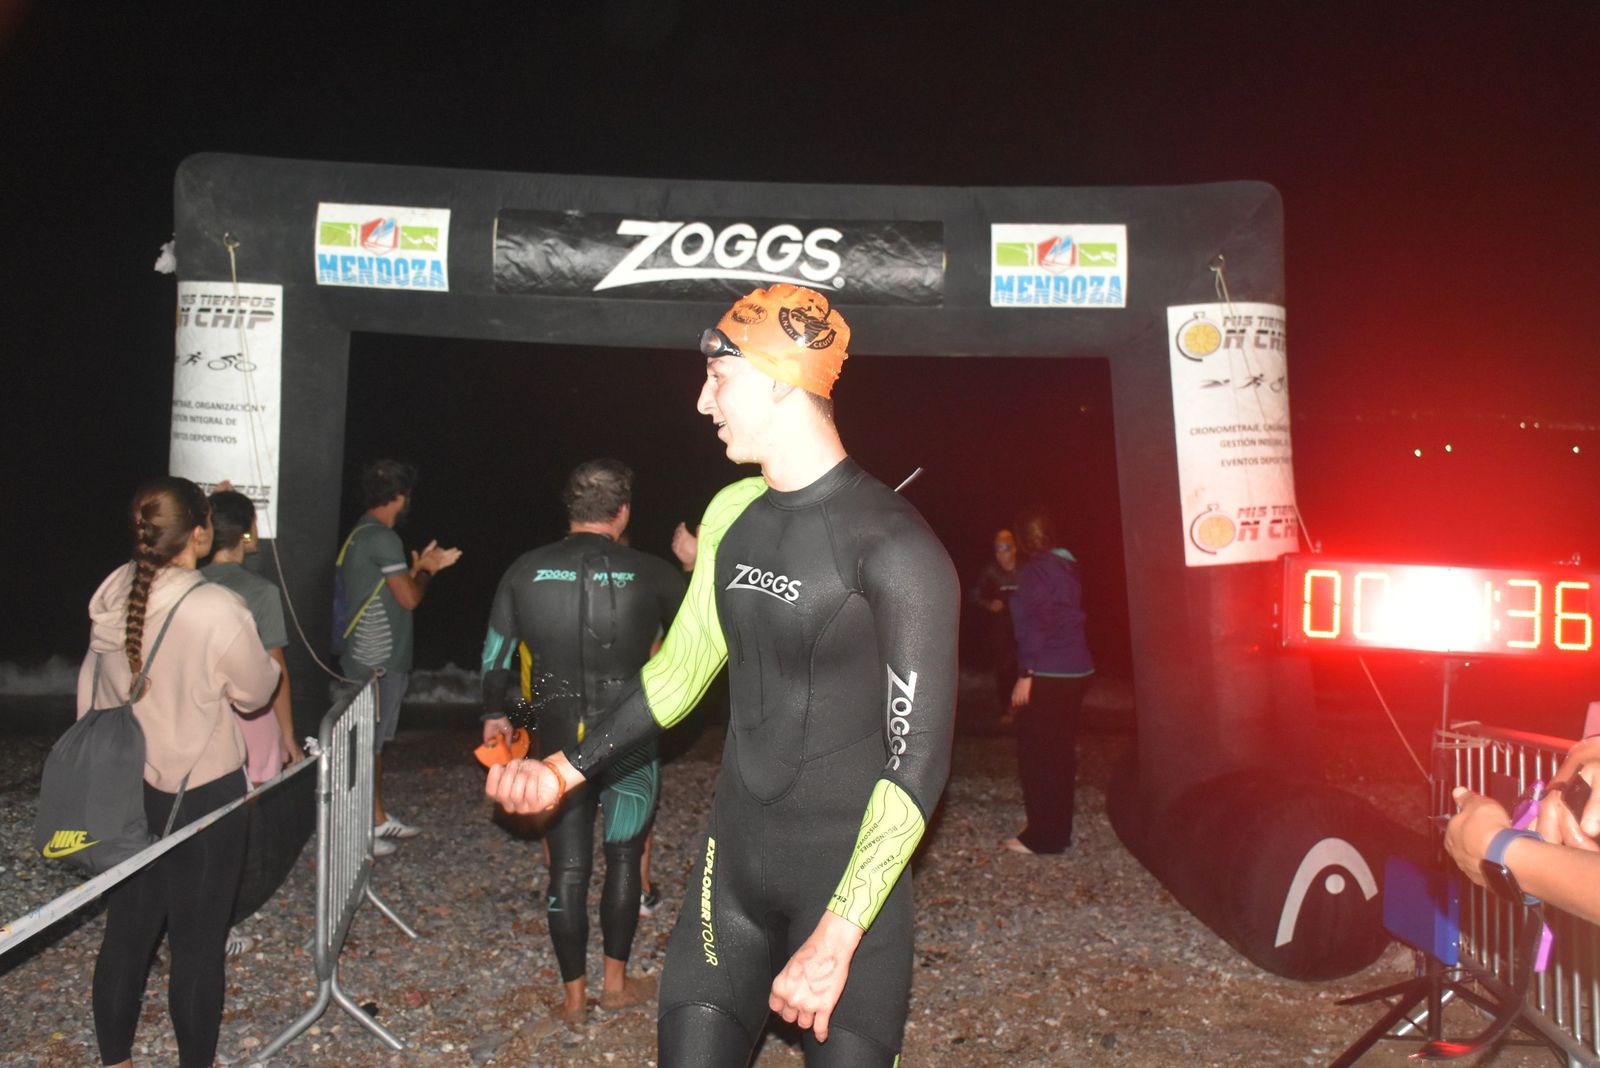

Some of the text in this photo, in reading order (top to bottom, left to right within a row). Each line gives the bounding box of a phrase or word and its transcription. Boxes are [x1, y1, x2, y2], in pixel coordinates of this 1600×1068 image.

[593, 218, 844, 291] ZOGGS
[317, 254, 448, 288] MENDOZA
[994, 275, 1123, 304] MENDOZA
[200, 294, 276, 308] TIEMPOS
[195, 307, 275, 329] CHIP
[1223, 315, 1253, 327] MIS
[195, 401, 258, 412] ORGANIZACIÓN
[189, 415, 223, 425] INTEGRAL
[225, 417, 237, 426] DE
[189, 433, 237, 444] DEPORTIVOS
[1221, 458, 1258, 467] EVENTOS
[1238, 506, 1267, 518] MIS
[533, 569, 577, 582] ZOGGS
[725, 563, 802, 606] ZOGGS
[50, 830, 87, 848] NIKE
[859, 855, 875, 870] YOUR
